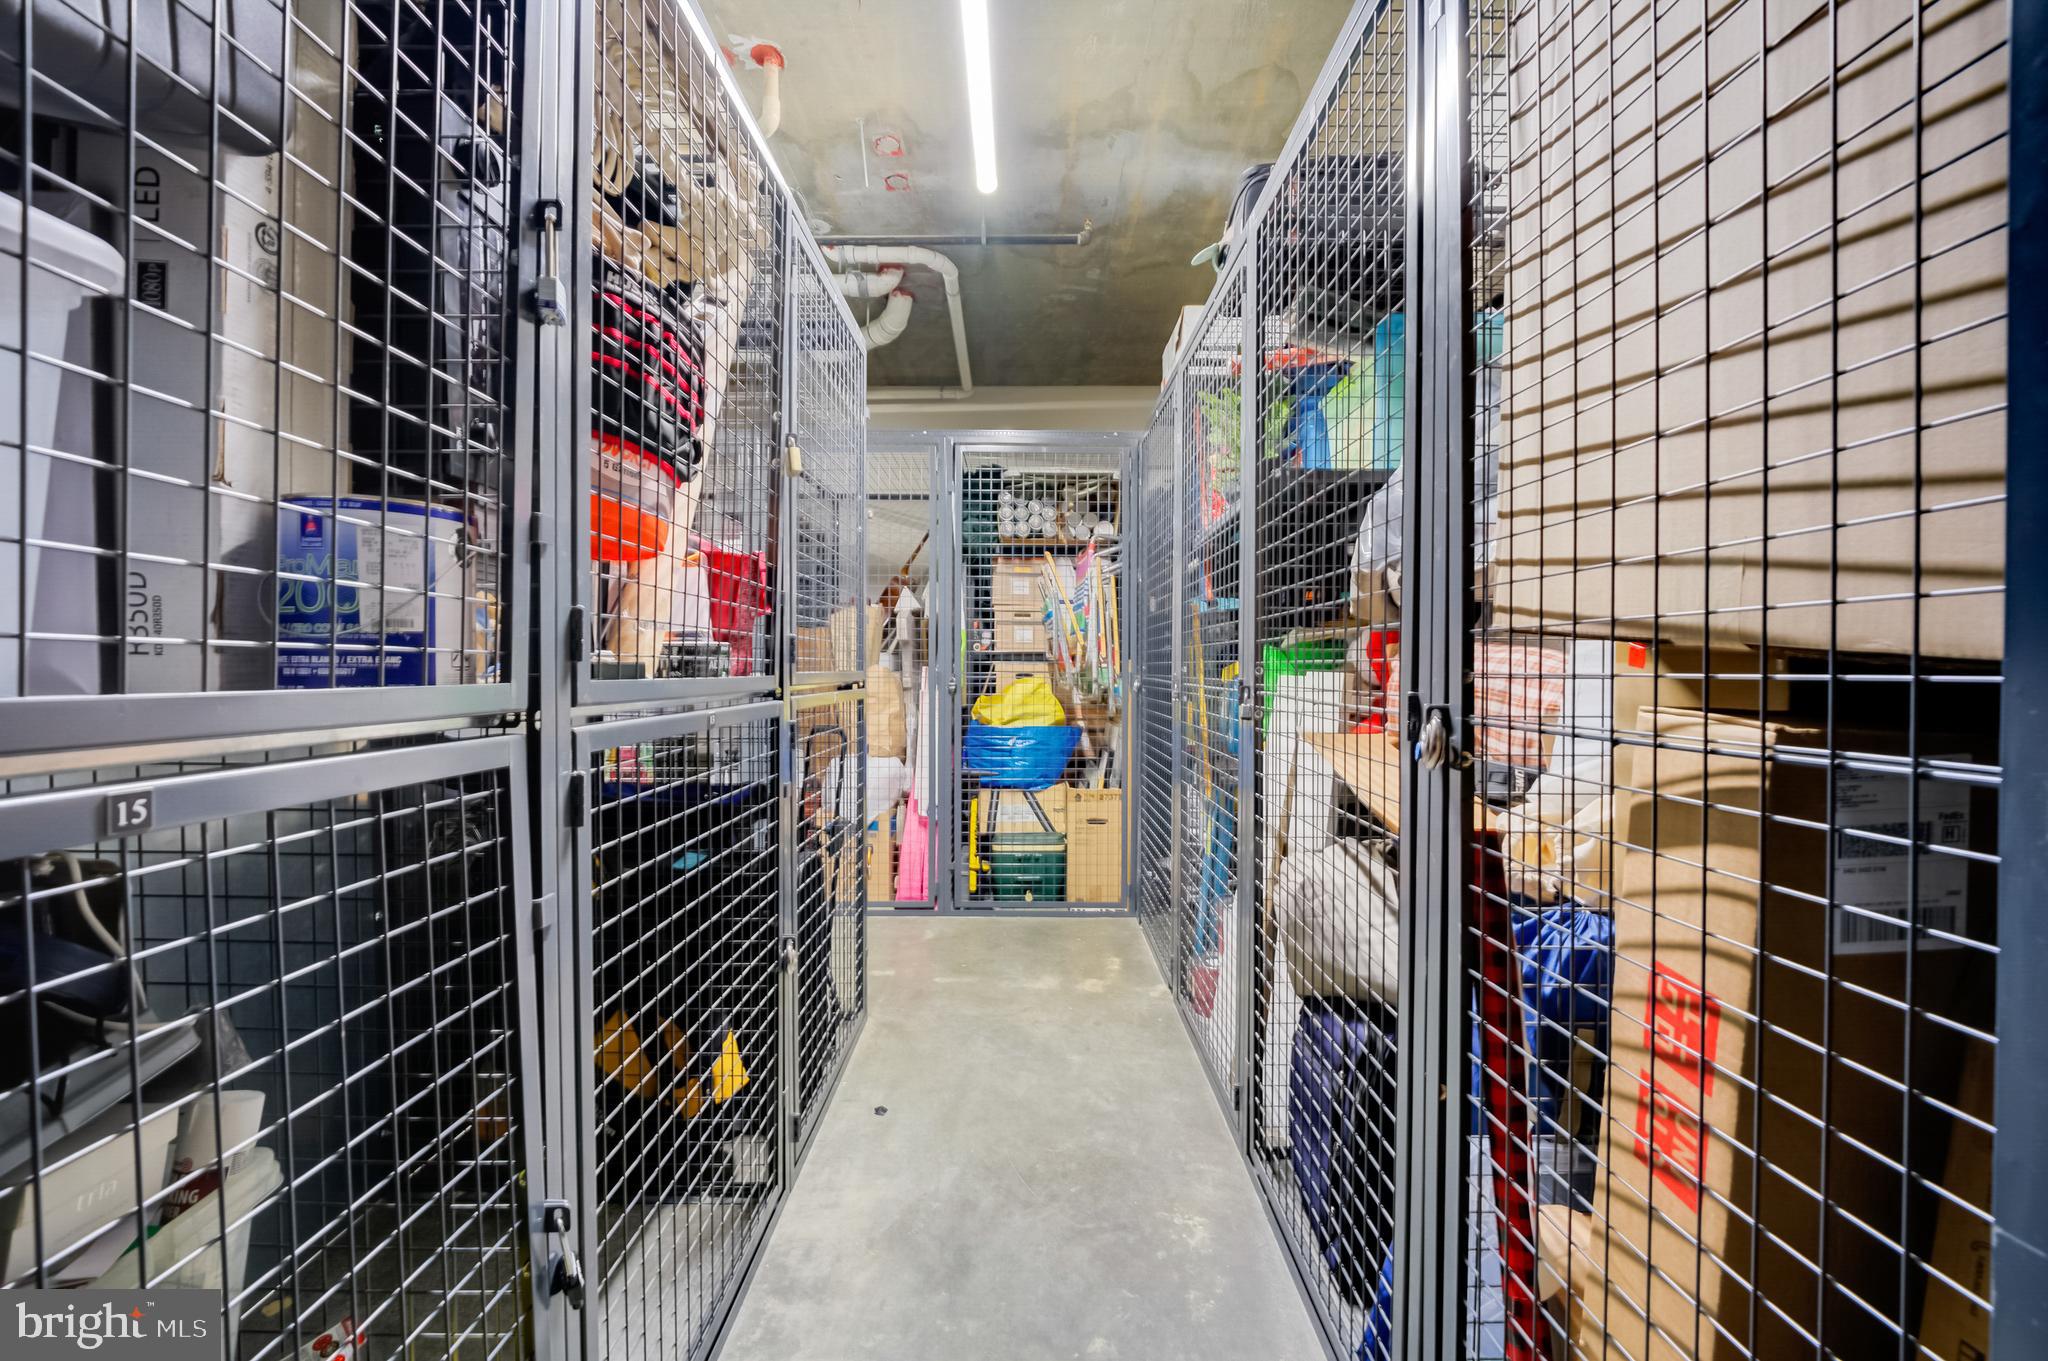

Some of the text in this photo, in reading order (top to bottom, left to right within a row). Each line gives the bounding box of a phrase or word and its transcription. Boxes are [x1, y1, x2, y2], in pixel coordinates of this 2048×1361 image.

[134, 166, 160, 222] LED
[279, 575, 359, 613] 200
[151, 594, 164, 656] KD40R350D
[347, 656, 374, 664] EXTRA
[375, 656, 402, 664] BANC
[117, 798, 148, 827] 15
